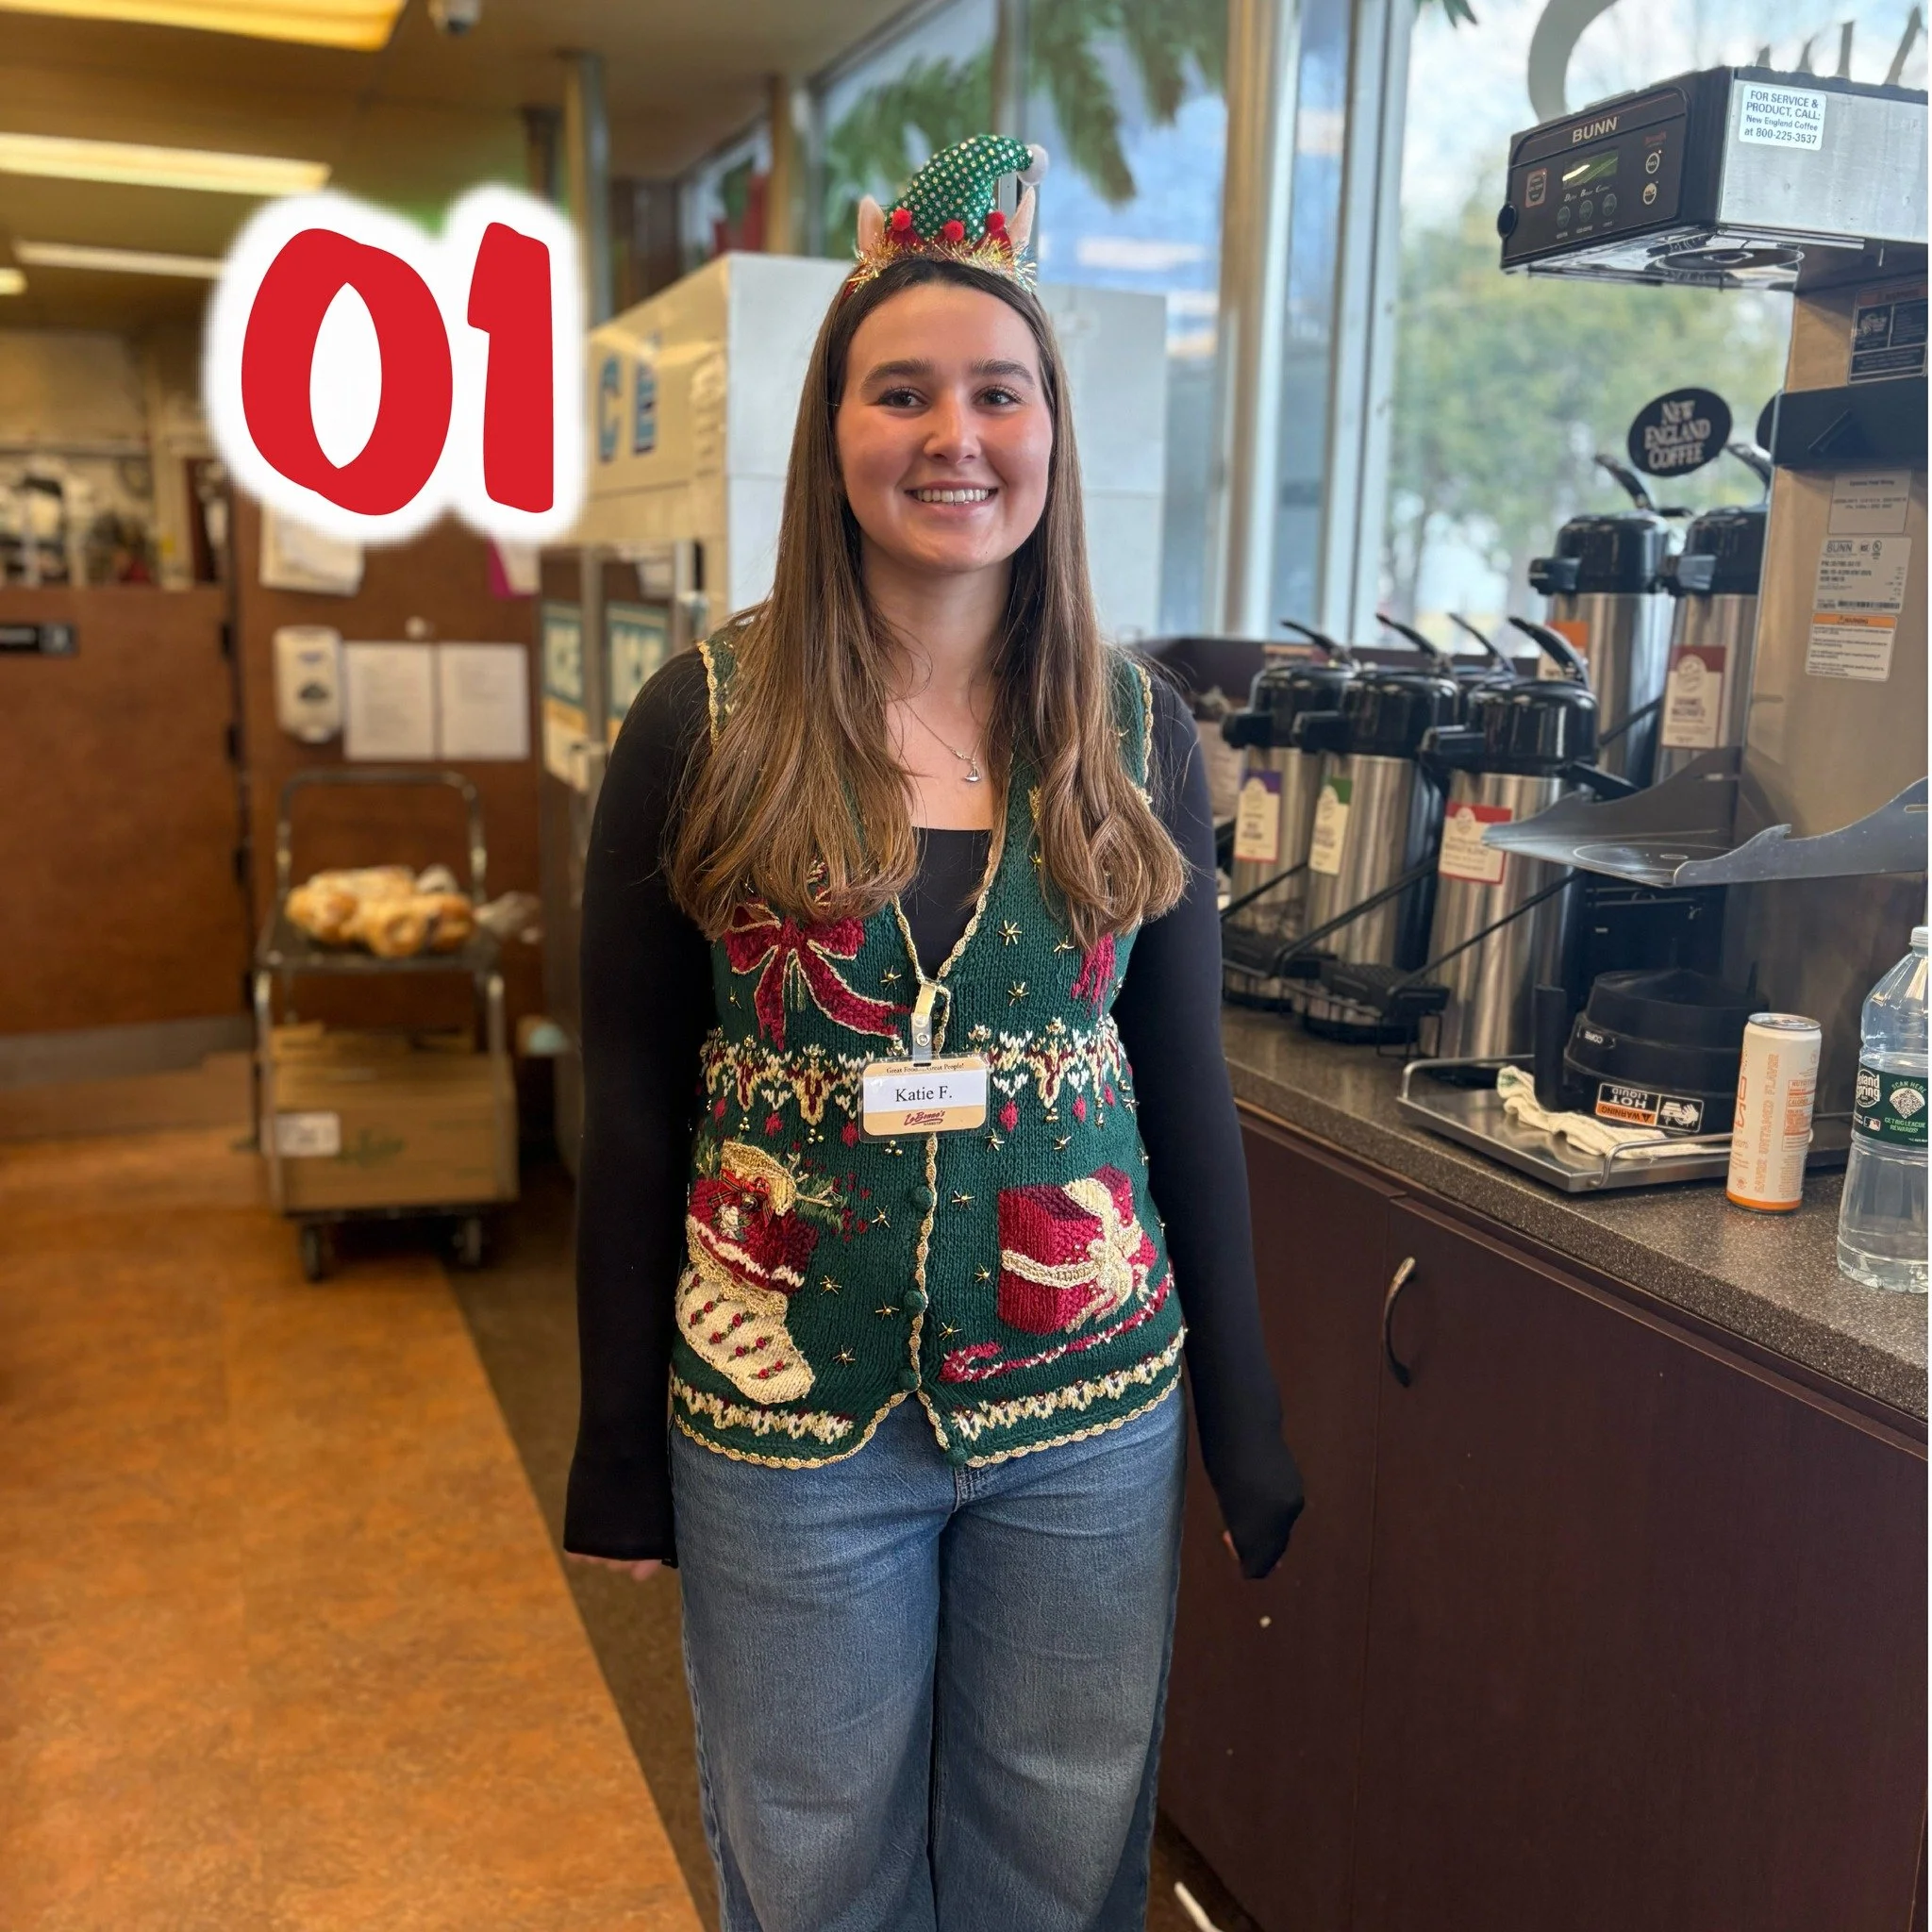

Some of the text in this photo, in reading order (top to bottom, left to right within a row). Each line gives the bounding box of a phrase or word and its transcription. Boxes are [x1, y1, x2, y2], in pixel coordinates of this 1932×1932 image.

[1750, 90, 1819, 108] FOR SERVICE &
[1746, 101, 1821, 120] PRODUCT, CALL:
[1572, 116, 1618, 143] BUNN
[1746, 115, 1818, 131] New England Coffee
[1744, 127, 1817, 144] at 800-225-3537
[1661, 399, 1695, 426] NEW
[1643, 418, 1711, 450] ENGLAND
[1648, 441, 1704, 471] COFFEE
[1825, 543, 1853, 554] BUNN
[944, 1062, 964, 1072] People!
[895, 1085, 953, 1102] Katie F.
[1611, 1088, 1648, 1100] LIQUID
[1890, 1081, 1927, 1094] SCAN HERE
[1609, 1094, 1647, 1109] HOT
[1601, 1106, 1639, 1122] WARNING
